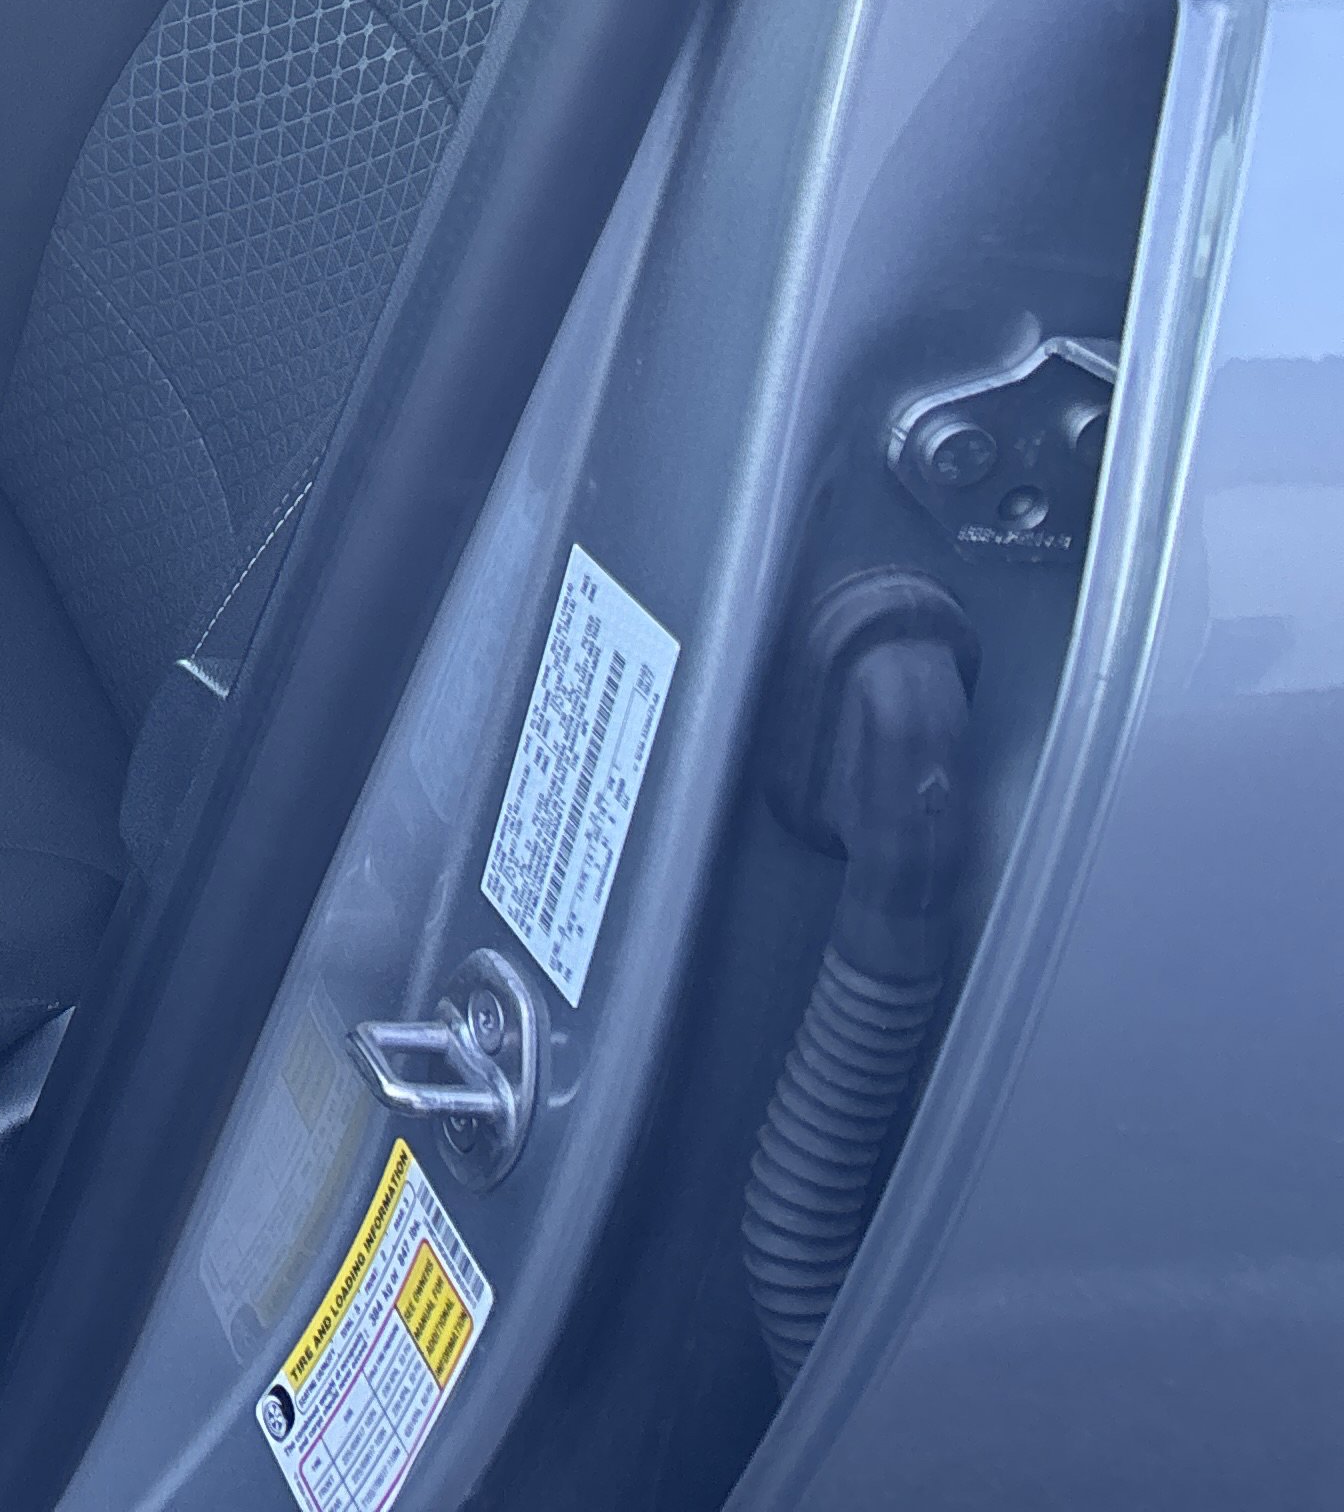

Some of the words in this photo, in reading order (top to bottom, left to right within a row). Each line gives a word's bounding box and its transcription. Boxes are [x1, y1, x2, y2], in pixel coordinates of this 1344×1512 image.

[291, 1345, 313, 1381] TIRE
[311, 1315, 332, 1350] AND
[329, 1252, 366, 1318] LOADING
[361, 1148, 408, 1252] INFORMATION
[397, 1238, 410, 1267] 847
[402, 1298, 416, 1323] SEE
[413, 1297, 435, 1341] MANUAL
[431, 1274, 444, 1300] FOR
[425, 1297, 454, 1357] ADDITIONAL
[434, 1308, 468, 1378] INFORMATION
